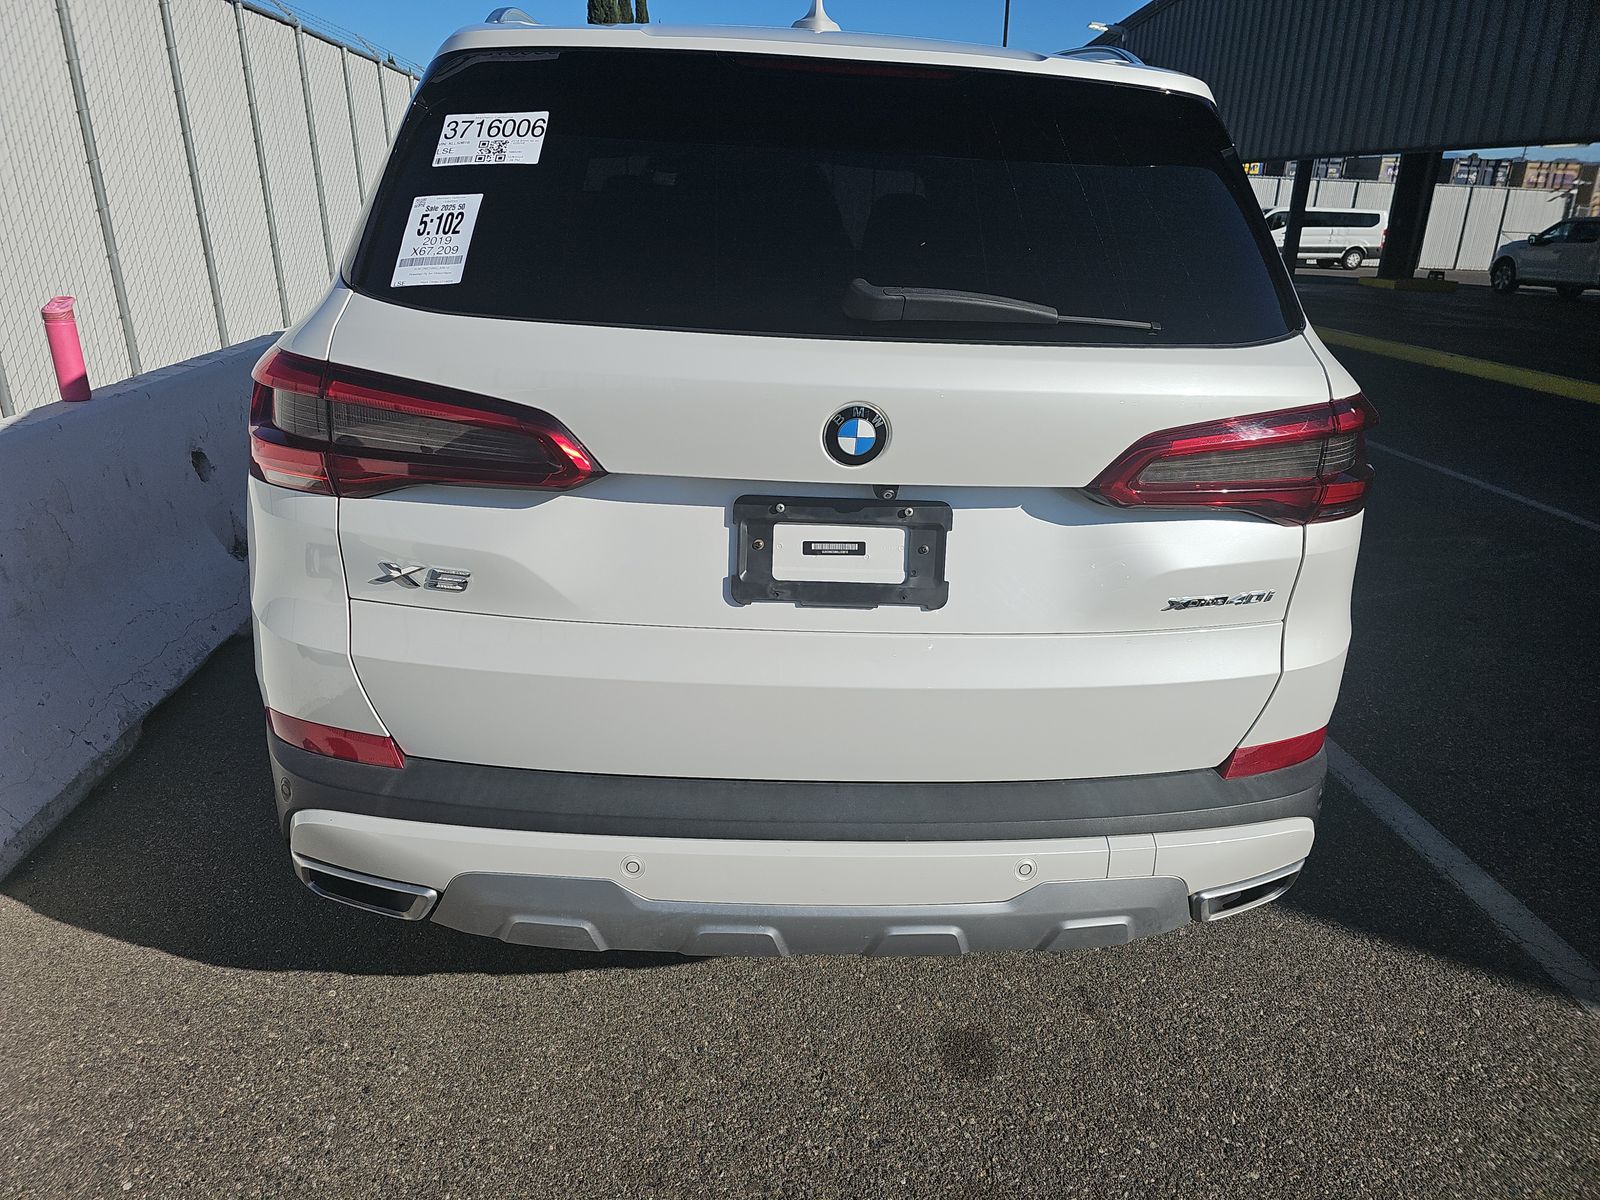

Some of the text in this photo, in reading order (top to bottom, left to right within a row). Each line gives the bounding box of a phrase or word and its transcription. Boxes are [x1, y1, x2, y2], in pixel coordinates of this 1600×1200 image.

[444, 118, 546, 140] 3716006
[441, 203, 457, 212] 2025
[457, 203, 466, 211] 50
[416, 211, 465, 237] 5:102
[411, 245, 459, 257] X67,209
[423, 235, 453, 246] 2019
[832, 406, 884, 427] BMW
[367, 560, 471, 593] X5
